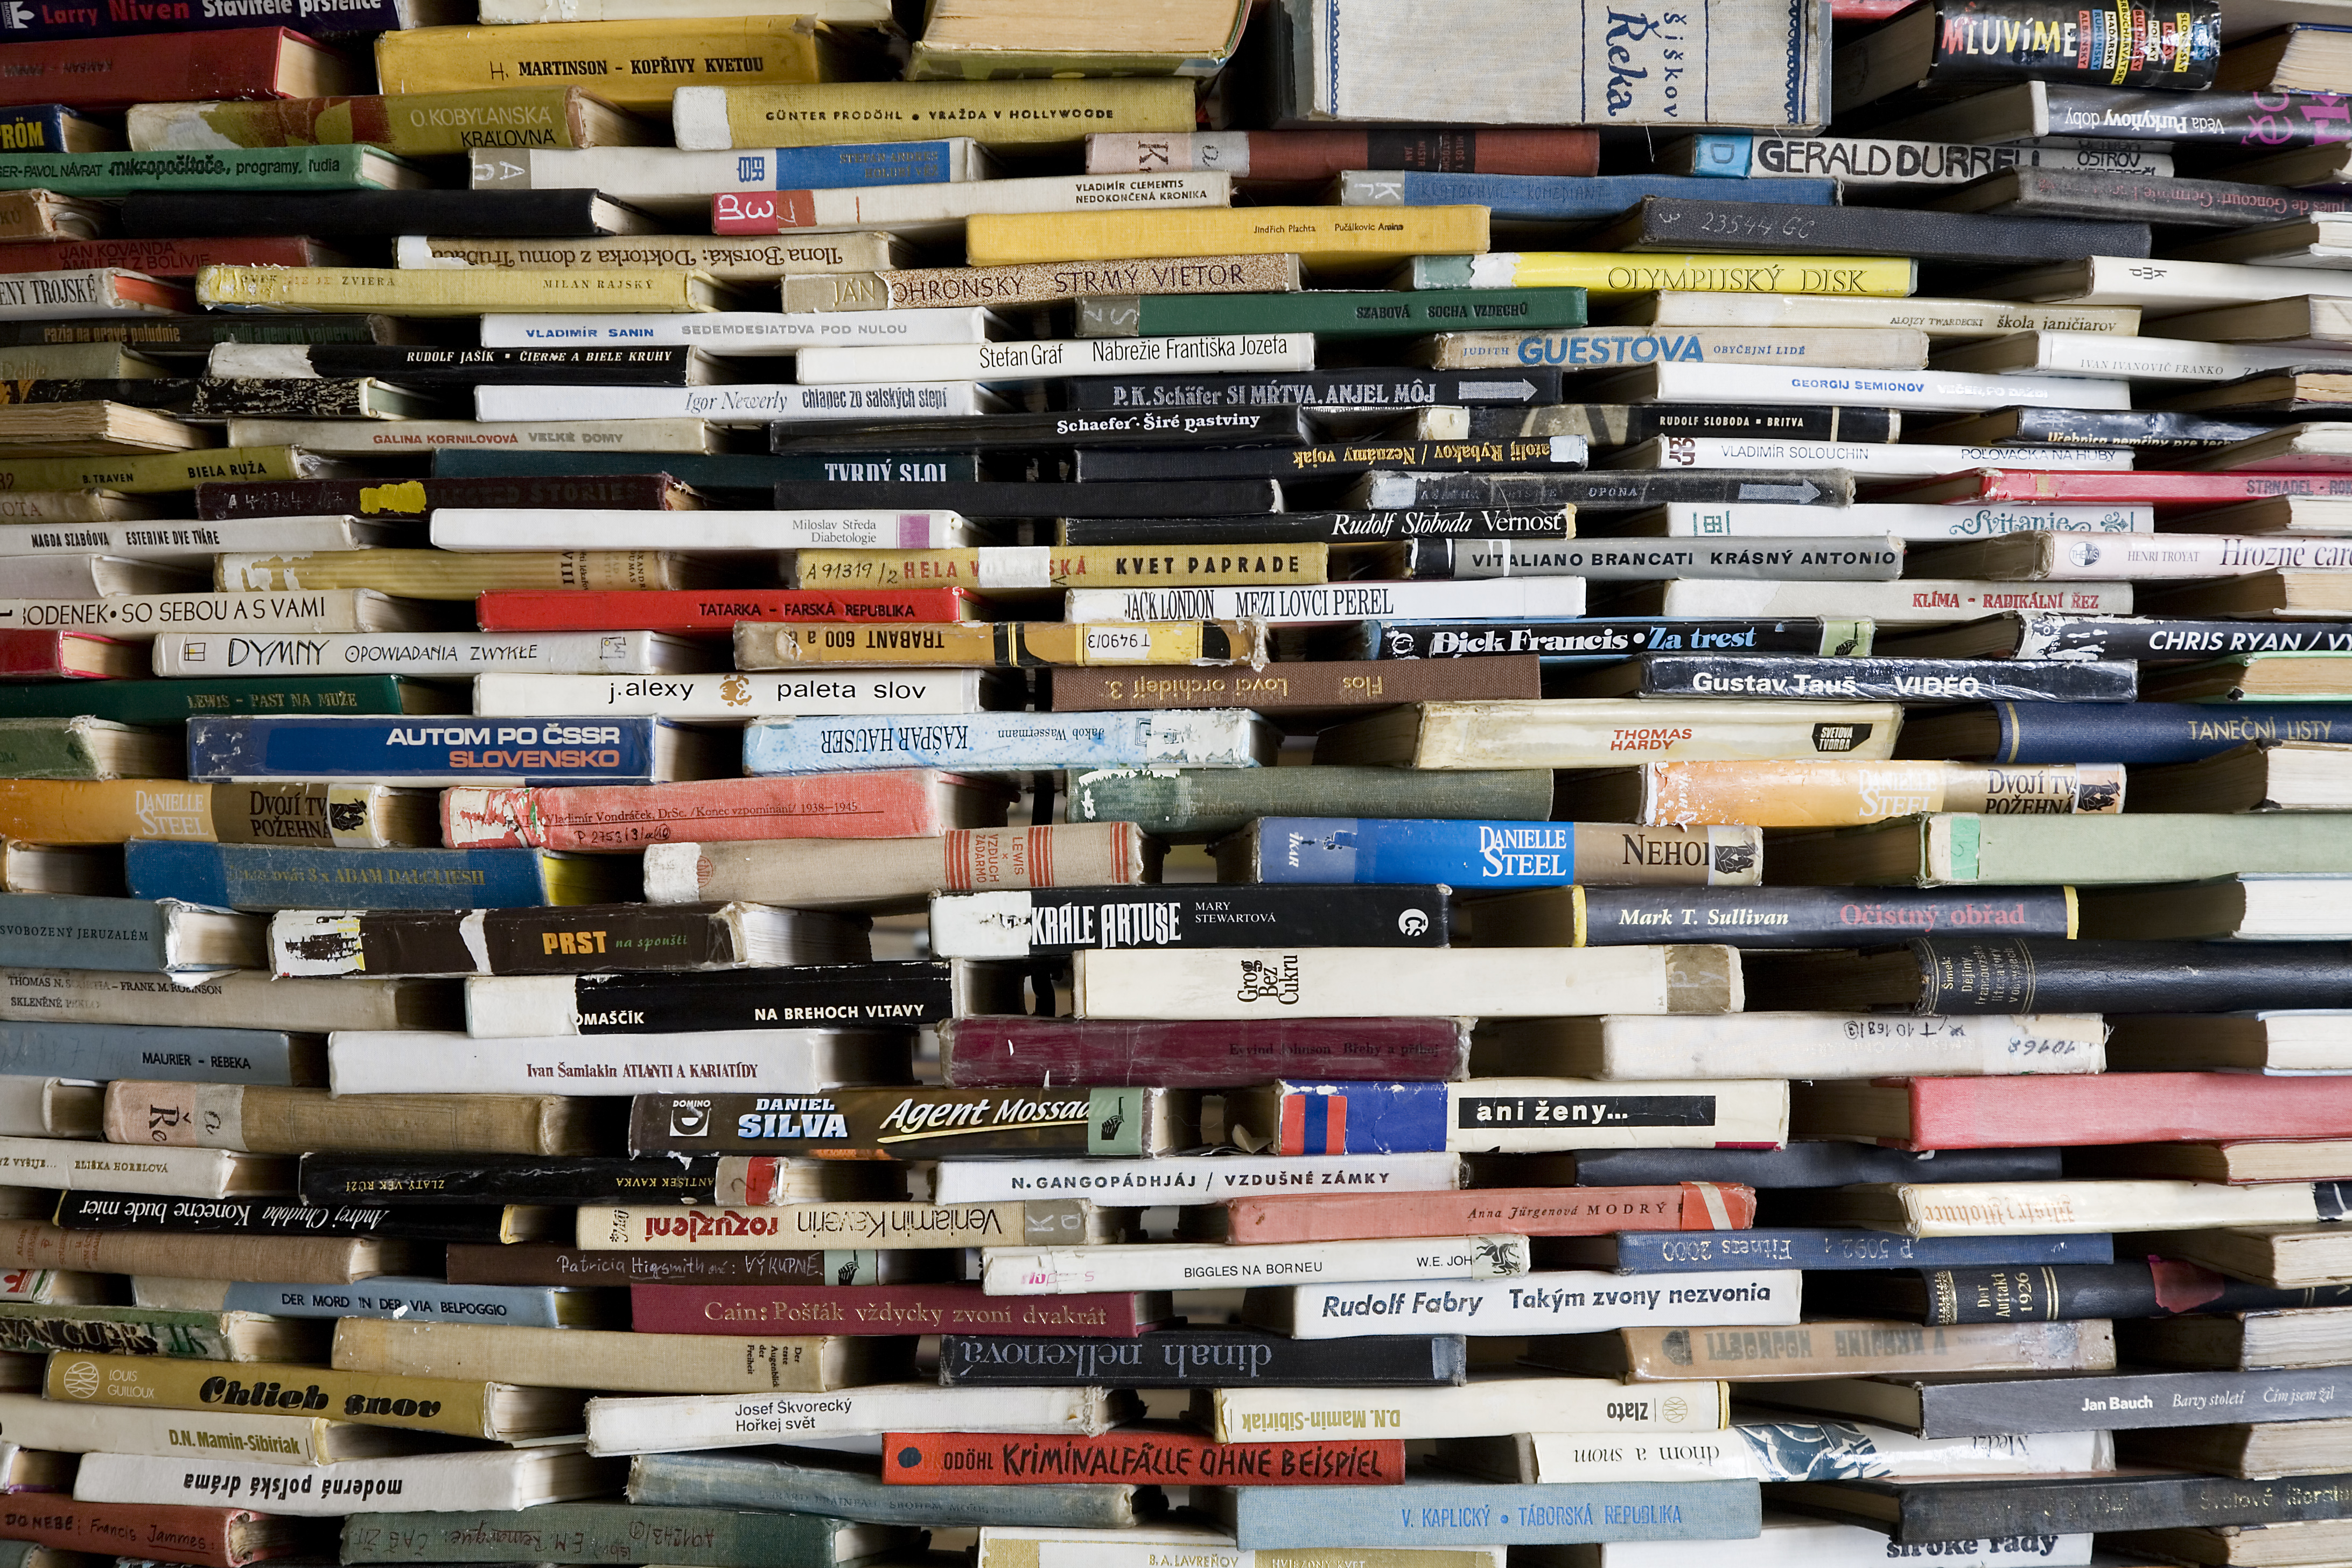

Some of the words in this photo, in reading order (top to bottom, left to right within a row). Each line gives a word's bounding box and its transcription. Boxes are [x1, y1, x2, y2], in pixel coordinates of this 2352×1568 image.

[1942, 17, 2078, 58] MLUVÍME
[2093, 12, 2103, 69] RUMUNSKY
[519, 60, 607, 76] MARTINSON
[631, 56, 696, 74] KOPŘIVY
[704, 57, 764, 73] KVETOU
[1606, 4, 1662, 117] Řeka
[766, 108, 827, 121] GÜNTER
[834, 108, 902, 121] PRODÖHL
[928, 108, 986, 121] VRAŽDA
[993, 110, 1002, 120] V
[2065, 108, 2101, 127] doby
[2104, 109, 2188, 134] Purkyňovy
[2194, 117, 2225, 135] Věda
[60, 160, 103, 178] NÁVRAT
[108, 153, 230, 179] mikropočítače,
[307, 158, 340, 173] ľudia
[1076, 180, 1124, 192] VLADIMÍR
[1130, 179, 1184, 190] CLEMENTIS
[1076, 190, 1156, 204] NEDOKONČENÁ
[1160, 190, 1208, 200] KRONIKA
[1253, 224, 1285, 234] Jindřich
[1288, 224, 1316, 233] Plachta
[1055, 264, 1138, 294] STRMÝ
[1151, 263, 1245, 289] VIETOR
[526, 326, 597, 339] VLADIMÍR
[608, 328, 654, 338] SANIN
[681, 325, 814, 335] SEDEMDESIATDVA
[821, 326, 851, 335] POD
[858, 325, 907, 334] NULOU
[1890, 316, 1924, 326] ALOJZY
[1929, 318, 1983, 327] TWARDECKI
[1997, 314, 2034, 329] škola
[2043, 316, 2117, 332] janičiarov
[979, 343, 1029, 369] Štefan
[1031, 343, 1063, 366] Gráf
[1093, 338, 1160, 362] Nábrežie
[1166, 335, 1236, 358] Františka
[1240, 335, 1287, 357] Jozefa
[1463, 346, 1509, 357] JUDITH
[1517, 335, 1704, 365] GUESTOVA
[1713, 344, 1772, 354] OBYČEJNÍ
[1776, 345, 1805, 355] LIDÉ
[685, 393, 717, 414] Igor
[721, 391, 787, 413] Newerly
[802, 389, 845, 409] chlapec
[849, 389, 862, 408] zo
[866, 388, 915, 408] salských
[919, 387, 947, 409] stepí
[1660, 416, 1699, 427] RUDOLF
[1703, 416, 1750, 427] SLOBODA
[1767, 417, 1804, 428] BRITVA
[82, 474, 91, 484] B.
[93, 473, 134, 484] TRAVEN
[188, 464, 226, 479] BIELA
[229, 461, 267, 475] RUŽA
[793, 519, 837, 531] Miloslav
[843, 519, 877, 530] Středa
[31, 533, 61, 548] MAGDA
[125, 531, 169, 545] ESTERINE
[173, 530, 190, 544] DVE
[194, 529, 220, 544] TVÁRE
[810, 531, 877, 544] Diabetologie
[1116, 557, 1174, 575] KVET
[1189, 556, 1299, 573] PAPRADE
[2128, 551, 2158, 562] HENRI
[2161, 551, 2200, 562] TROYAT
[699, 603, 762, 617] TATARKA
[785, 601, 836, 617] FARSKÁ
[845, 603, 915, 617] REPUBLIKA
[1912, 592, 1960, 608] KLÍMA
[1983, 592, 2064, 609] RADIKÁLNÍ
[2071, 592, 2099, 609] ŘEZ
[1432, 631, 1506, 654] Dick
[1509, 628, 1628, 652] Francis
[1647, 626, 1685, 649] Za
[1691, 627, 1757, 648] trest
[228, 638, 330, 667] DYMNY
[345, 646, 458, 663] OPOWIADANIA
[608, 680, 694, 704] j.alexy
[777, 681, 856, 700] paleta
[873, 681, 926, 698] slov
[386, 727, 489, 745] AUTOM
[498, 727, 537, 745] PO
[543, 724, 620, 745] ČSSR
[1613, 728, 1692, 741] THOMAS
[2188, 717, 2276, 741] TANEČNÍ
[2287, 720, 2332, 741] LISTY
[1610, 739, 1675, 752] HARDY
[449, 750, 620, 768] SLOVENSKO
[1195, 901, 1230, 912] MARY
[1195, 911, 1276, 922] STEWARTOVÁ
[1619, 908, 1673, 926] Mark
[1682, 909, 1699, 925] T.
[1707, 908, 1789, 926] Sullivan
[1840, 904, 1940, 932] Očistný
[1950, 904, 2026, 925] obřad
[543, 931, 606, 955] PRST
[615, 939, 632, 949] na
[637, 933, 688, 953] spoušti
[1237, 959, 1263, 1003] Grog
[1259, 968, 1278, 998] Bez
[1278, 955, 1299, 1005] Cukru
[754, 1007, 778, 1021] NA
[785, 1005, 858, 1020] BREHOCH
[866, 1003, 924, 1018] VLTAVY
[142, 1052, 191, 1067] MAURIER
[211, 1054, 251, 1069] REBEKA
[756, 1098, 836, 1112] DANIEL
[1476, 1104, 1524, 1122] ani
[738, 1115, 849, 1139] SILVA
[74, 1160, 110, 1172] ELIŠKA
[114, 1160, 168, 1173] HORELOVÁ
[1224, 1169, 1314, 1186] VZDUŠNÉ
[1322, 1169, 1390, 1186] ZÁMKY
[1184, 1265, 1238, 1278] BIGGLES
[1242, 1264, 1262, 1277] NA
[1266, 1261, 1323, 1276] BORNEU
[1322, 1291, 1404, 1318] Rudolf
[1412, 1290, 1484, 1318] Fabry
[1509, 1287, 1586, 1314] Takým
[1593, 1290, 1661, 1311] zvony
[1668, 1282, 1770, 1305] nezvonia
[1977, 1285, 1992, 1308] Der
[1996, 1272, 2011, 1318] Auftakt
[2019, 1272, 2034, 1312] 1926
[746, 1343, 754, 1376] Freiheit
[794, 1346, 803, 1364] Der
[108, 1369, 138, 1382] LOUIS
[771, 1345, 780, 1390] Augenblick
[108, 1383, 155, 1398] GUILLOUX
[199, 1376, 330, 1409] Chlieb
[344, 1394, 442, 1418] snov
[2081, 1396, 2106, 1412] Jan
[2110, 1394, 2154, 1411] Bauch
[2172, 1392, 2206, 1410] Barvy
[2209, 1390, 2245, 1406] století
[2263, 1386, 2288, 1405] Čím
[2289, 1387, 2315, 1405] jsem
[2319, 1385, 2335, 1403] žil
[735, 1402, 773, 1417] Josef
[777, 1398, 852, 1415] Škvorecký
[736, 1417, 782, 1433] Hořkej
[785, 1415, 816, 1431] svět
[169, 1429, 195, 1447] D.N.
[197, 1431, 302, 1455] Mamin-Sibiriak
[1199, 1448, 1271, 1478] OHNE
[183, 1473, 242, 1497] dráma
[250, 1474, 312, 1501] poľská
[321, 1478, 403, 1500] moderná
[1402, 1508, 1414, 1528] V.
[1422, 1504, 1490, 1528] KAPLICKÝ
[1518, 1502, 1593, 1526] TÁBORSKÁ
[1604, 1504, 1682, 1524] REPUBLIKA
